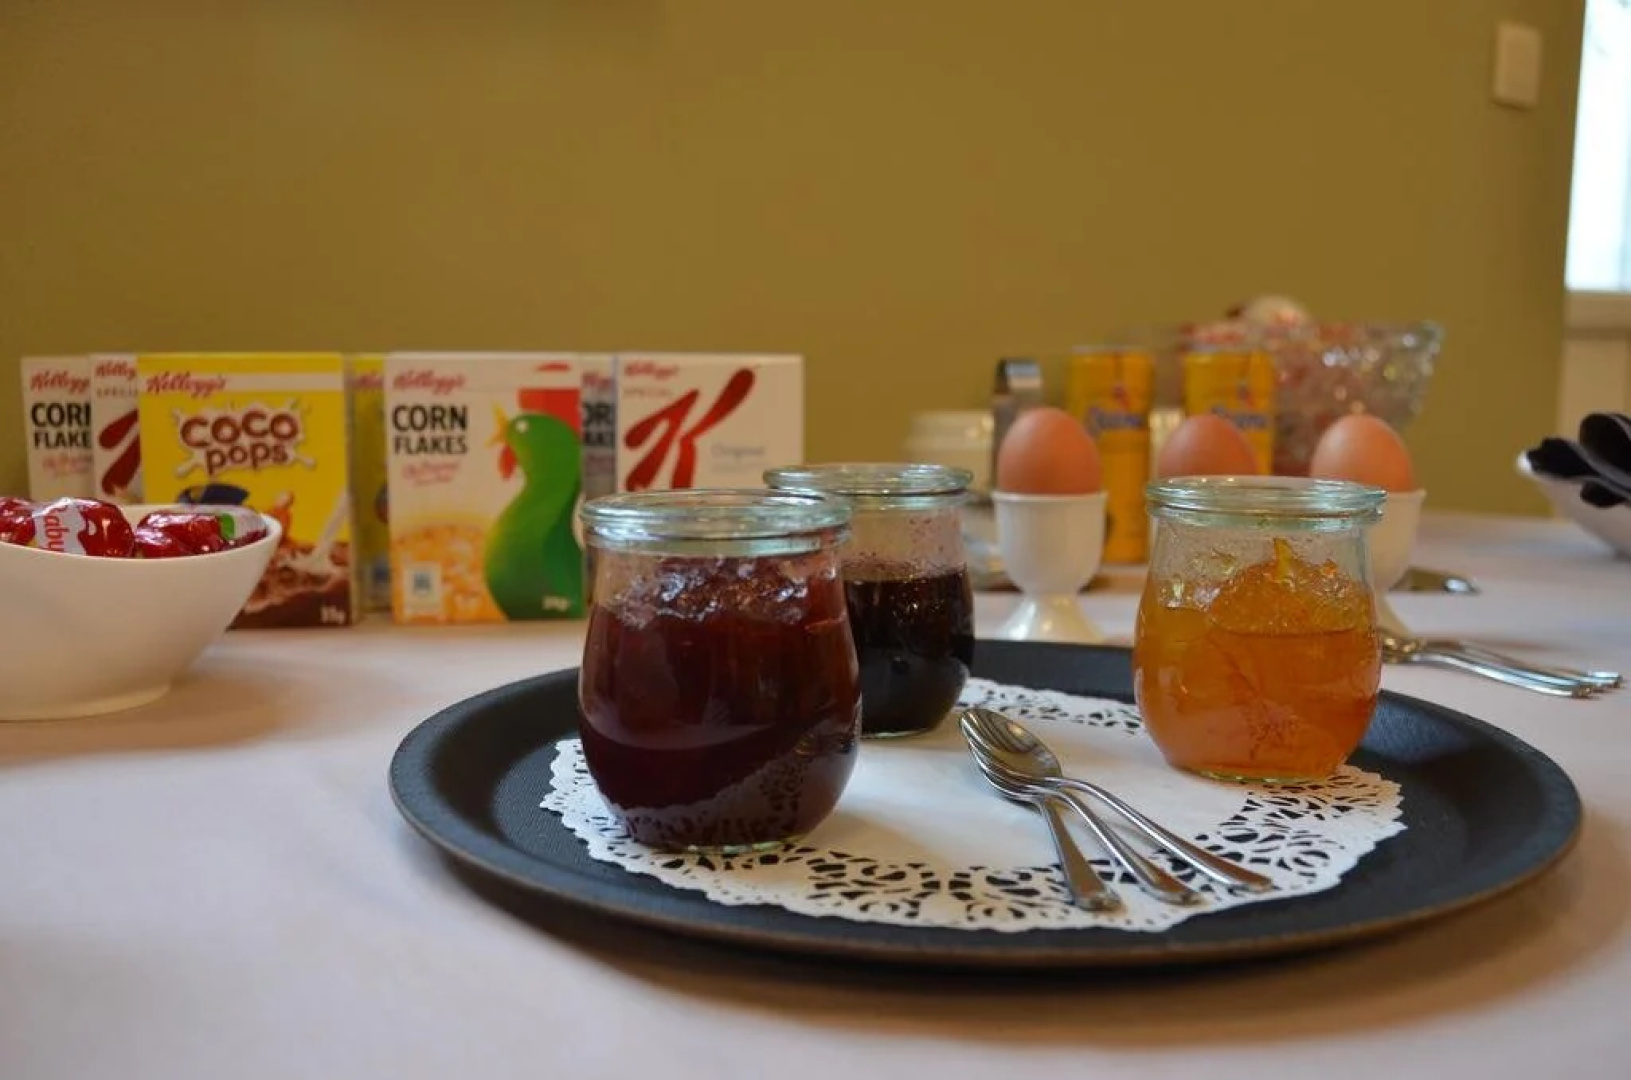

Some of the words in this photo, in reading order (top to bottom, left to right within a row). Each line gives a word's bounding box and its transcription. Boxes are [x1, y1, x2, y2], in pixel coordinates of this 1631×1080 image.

[146, 371, 226, 397] Kellogg's
[392, 404, 469, 432] CORN
[394, 435, 469, 455] FLAKES
